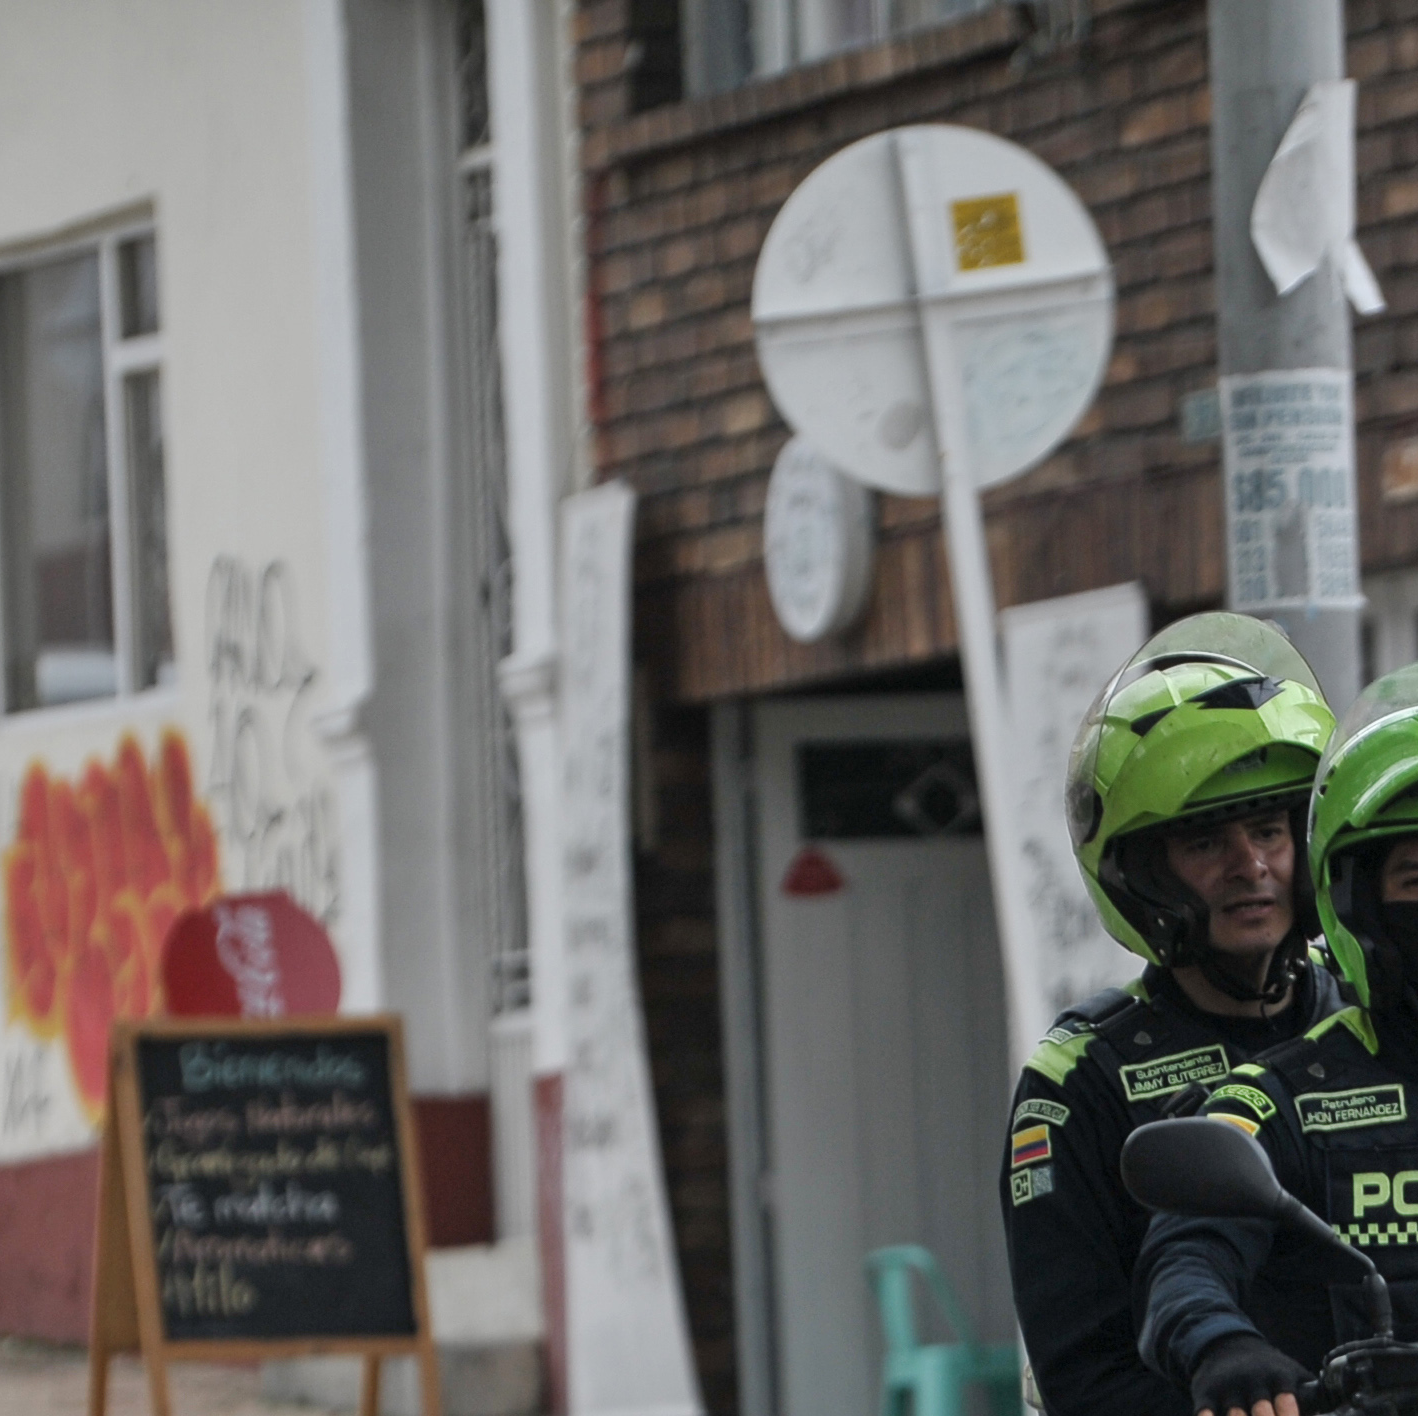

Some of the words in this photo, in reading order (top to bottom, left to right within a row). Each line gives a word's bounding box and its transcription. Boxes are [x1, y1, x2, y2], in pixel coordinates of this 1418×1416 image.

[1132, 1077, 1163, 1093] JIMMY
[1167, 1062, 1224, 1085] GUTIERREZ
[1136, 1055, 1211, 1079] Subintendente
[1305, 1112, 1332, 1124] JHON
[1335, 1103, 1399, 1121] FERNANDEZ
